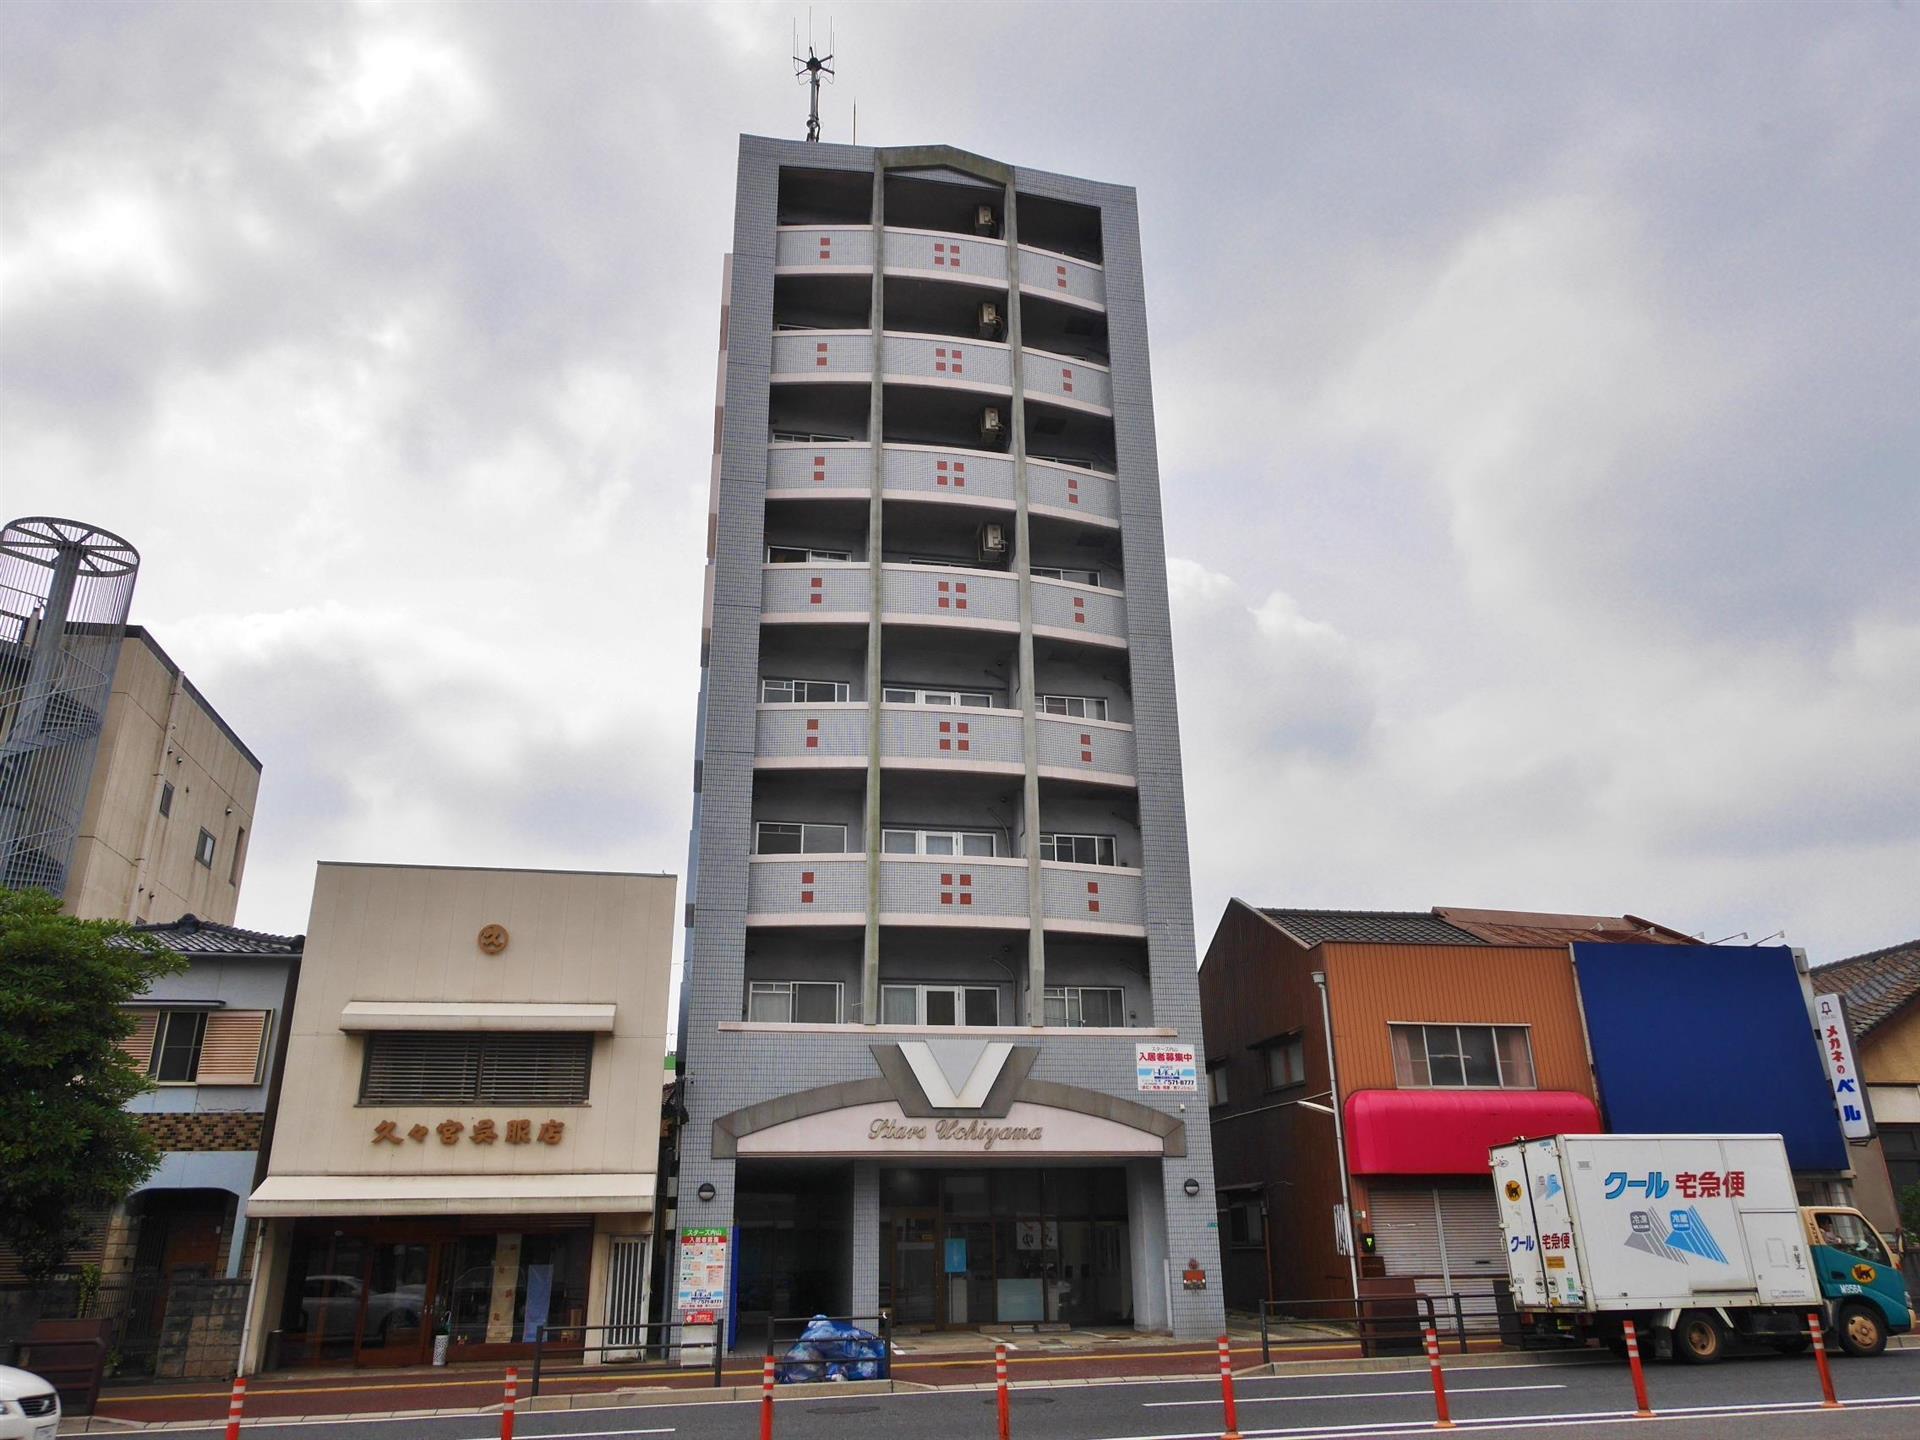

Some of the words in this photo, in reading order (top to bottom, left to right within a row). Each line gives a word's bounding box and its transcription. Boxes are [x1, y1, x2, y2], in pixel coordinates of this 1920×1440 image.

[1139, 1052, 1192, 1062] 入居者募集中
[1826, 1025, 1862, 1122] メガネのベル
[371, 1119, 565, 1145] 久々宮呉服店
[868, 1118, 927, 1140] Stars
[935, 1119, 1043, 1150] Uchiyama
[1604, 1171, 1670, 1200] クール
[1675, 1171, 1745, 1199] 宅急便
[1511, 1235, 1535, 1253] クール
[1541, 1232, 1571, 1250] 宅急便
